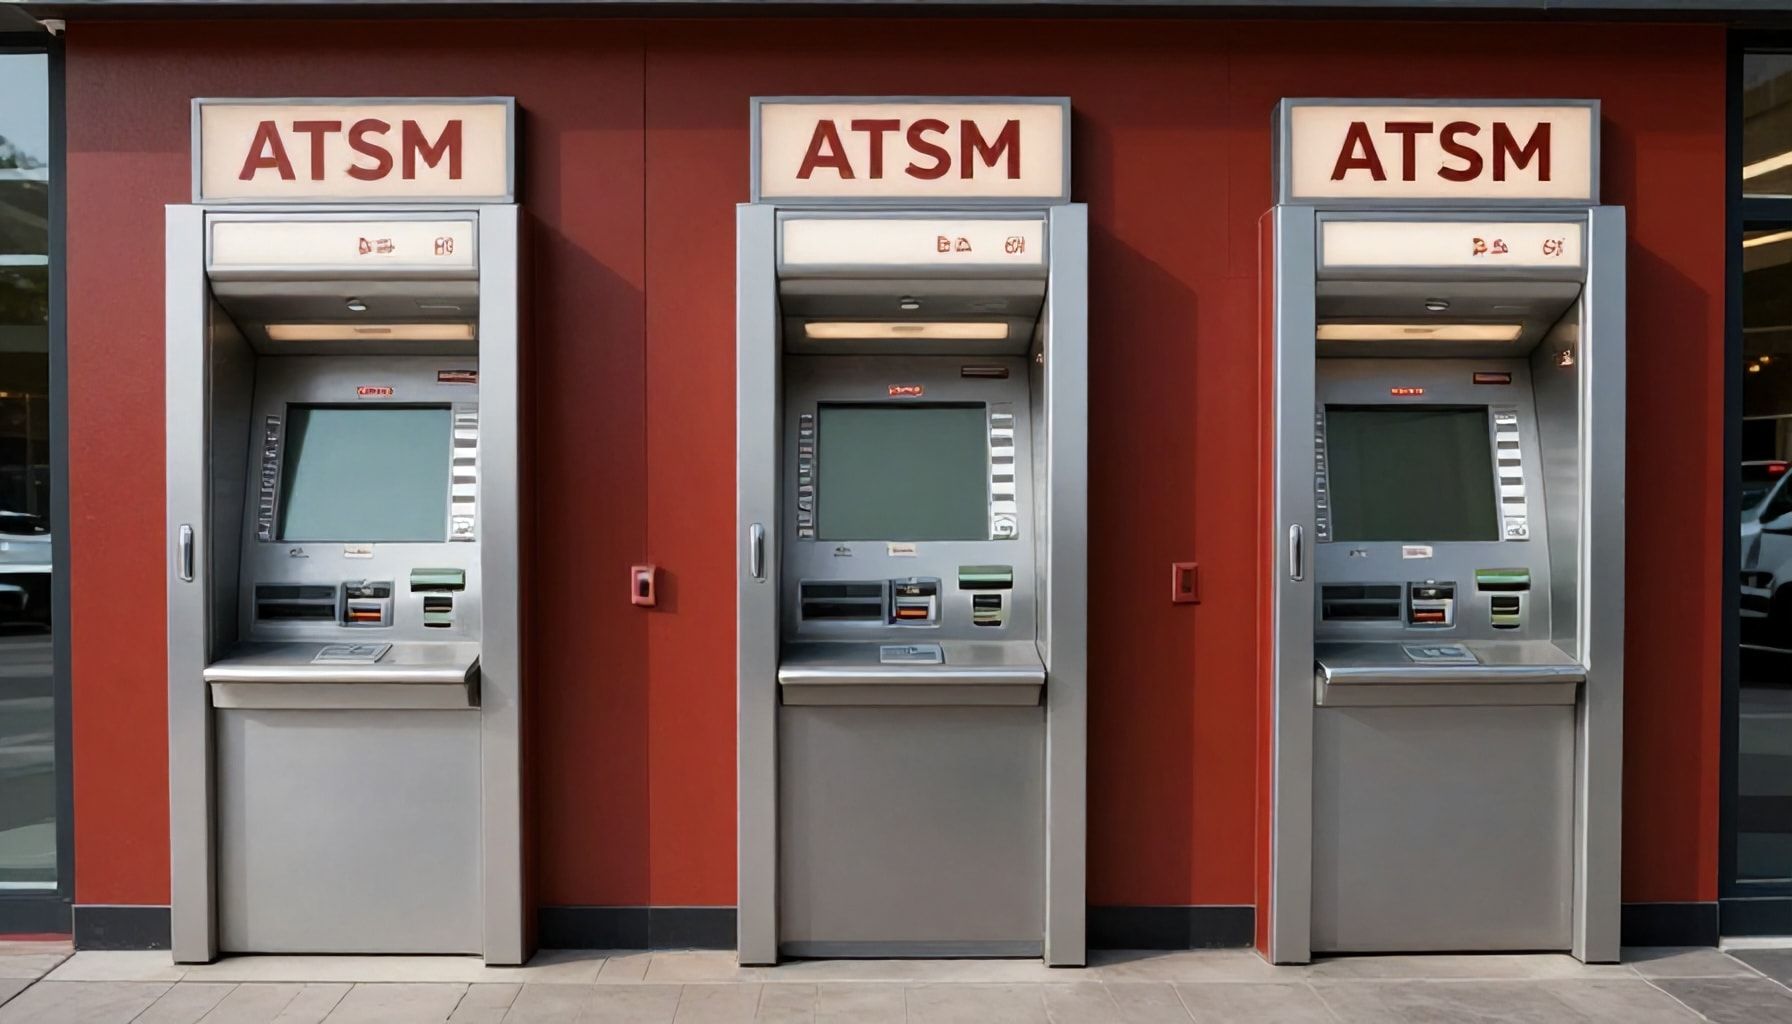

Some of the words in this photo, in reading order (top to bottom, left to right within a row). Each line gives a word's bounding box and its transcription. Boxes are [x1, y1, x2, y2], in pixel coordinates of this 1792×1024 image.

[240, 119, 462, 180] ATSM
[797, 119, 1020, 180] ATSM
[1331, 121, 1551, 182] ATSM
